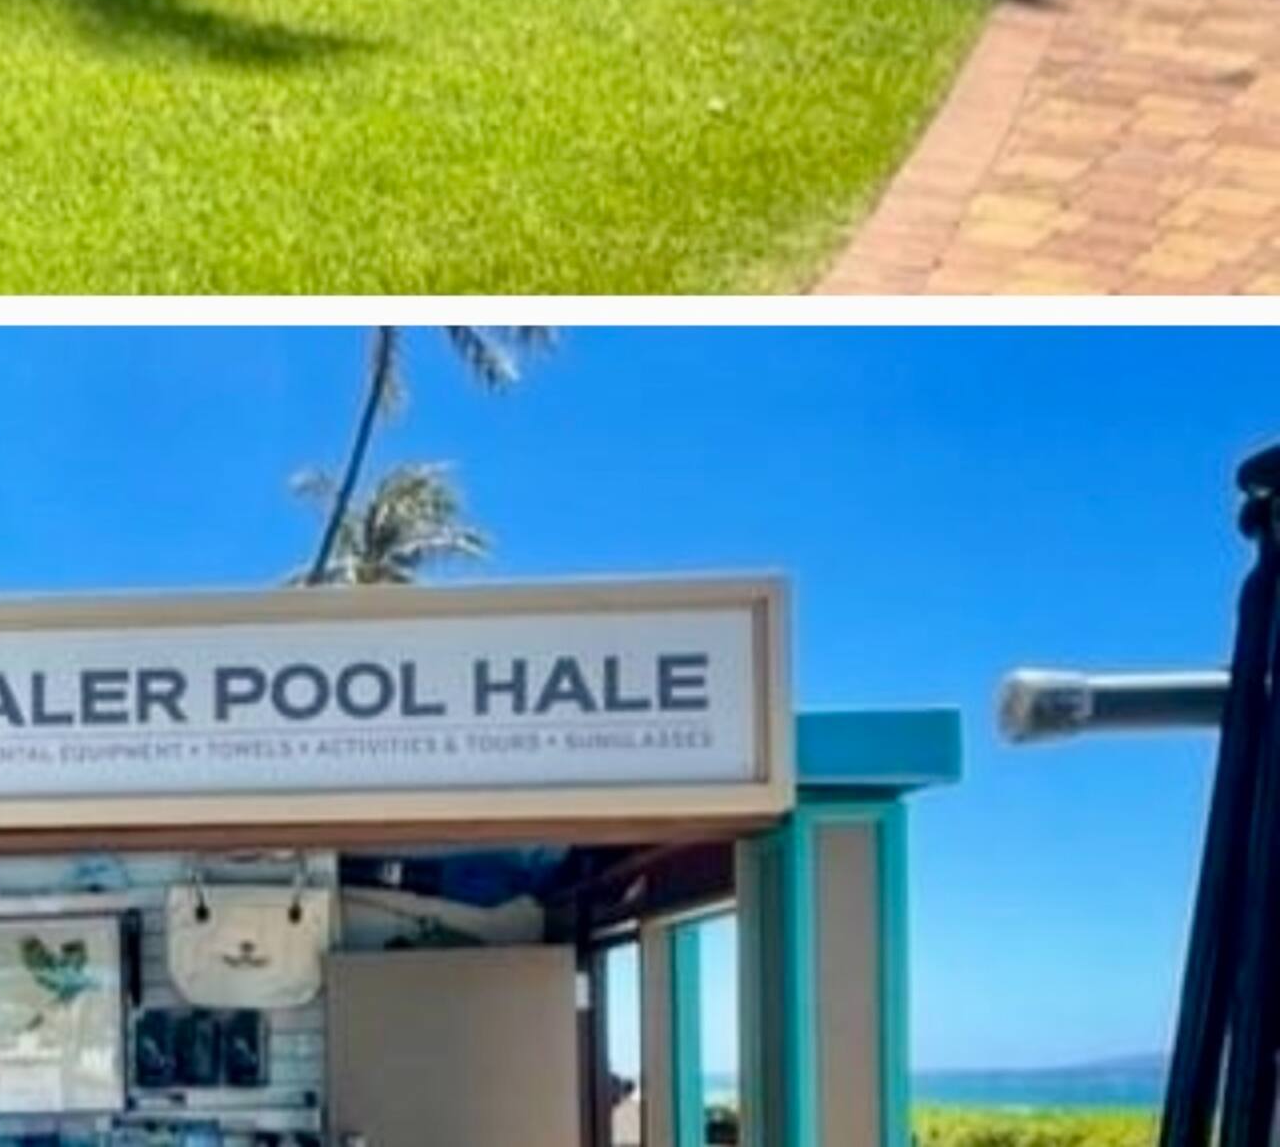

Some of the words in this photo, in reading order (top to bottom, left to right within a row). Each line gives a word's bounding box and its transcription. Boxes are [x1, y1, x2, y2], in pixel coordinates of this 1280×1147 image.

[214, 661, 446, 722] POOL
[473, 654, 710, 715] HALE
[59, 742, 184, 764] EQUIPMENT
[208, 739, 293, 759] TOWELS
[316, 735, 438, 756] ACTIVITIES
[467, 733, 541, 752] TOURS
[564, 729, 713, 749] SUNGLASSES
